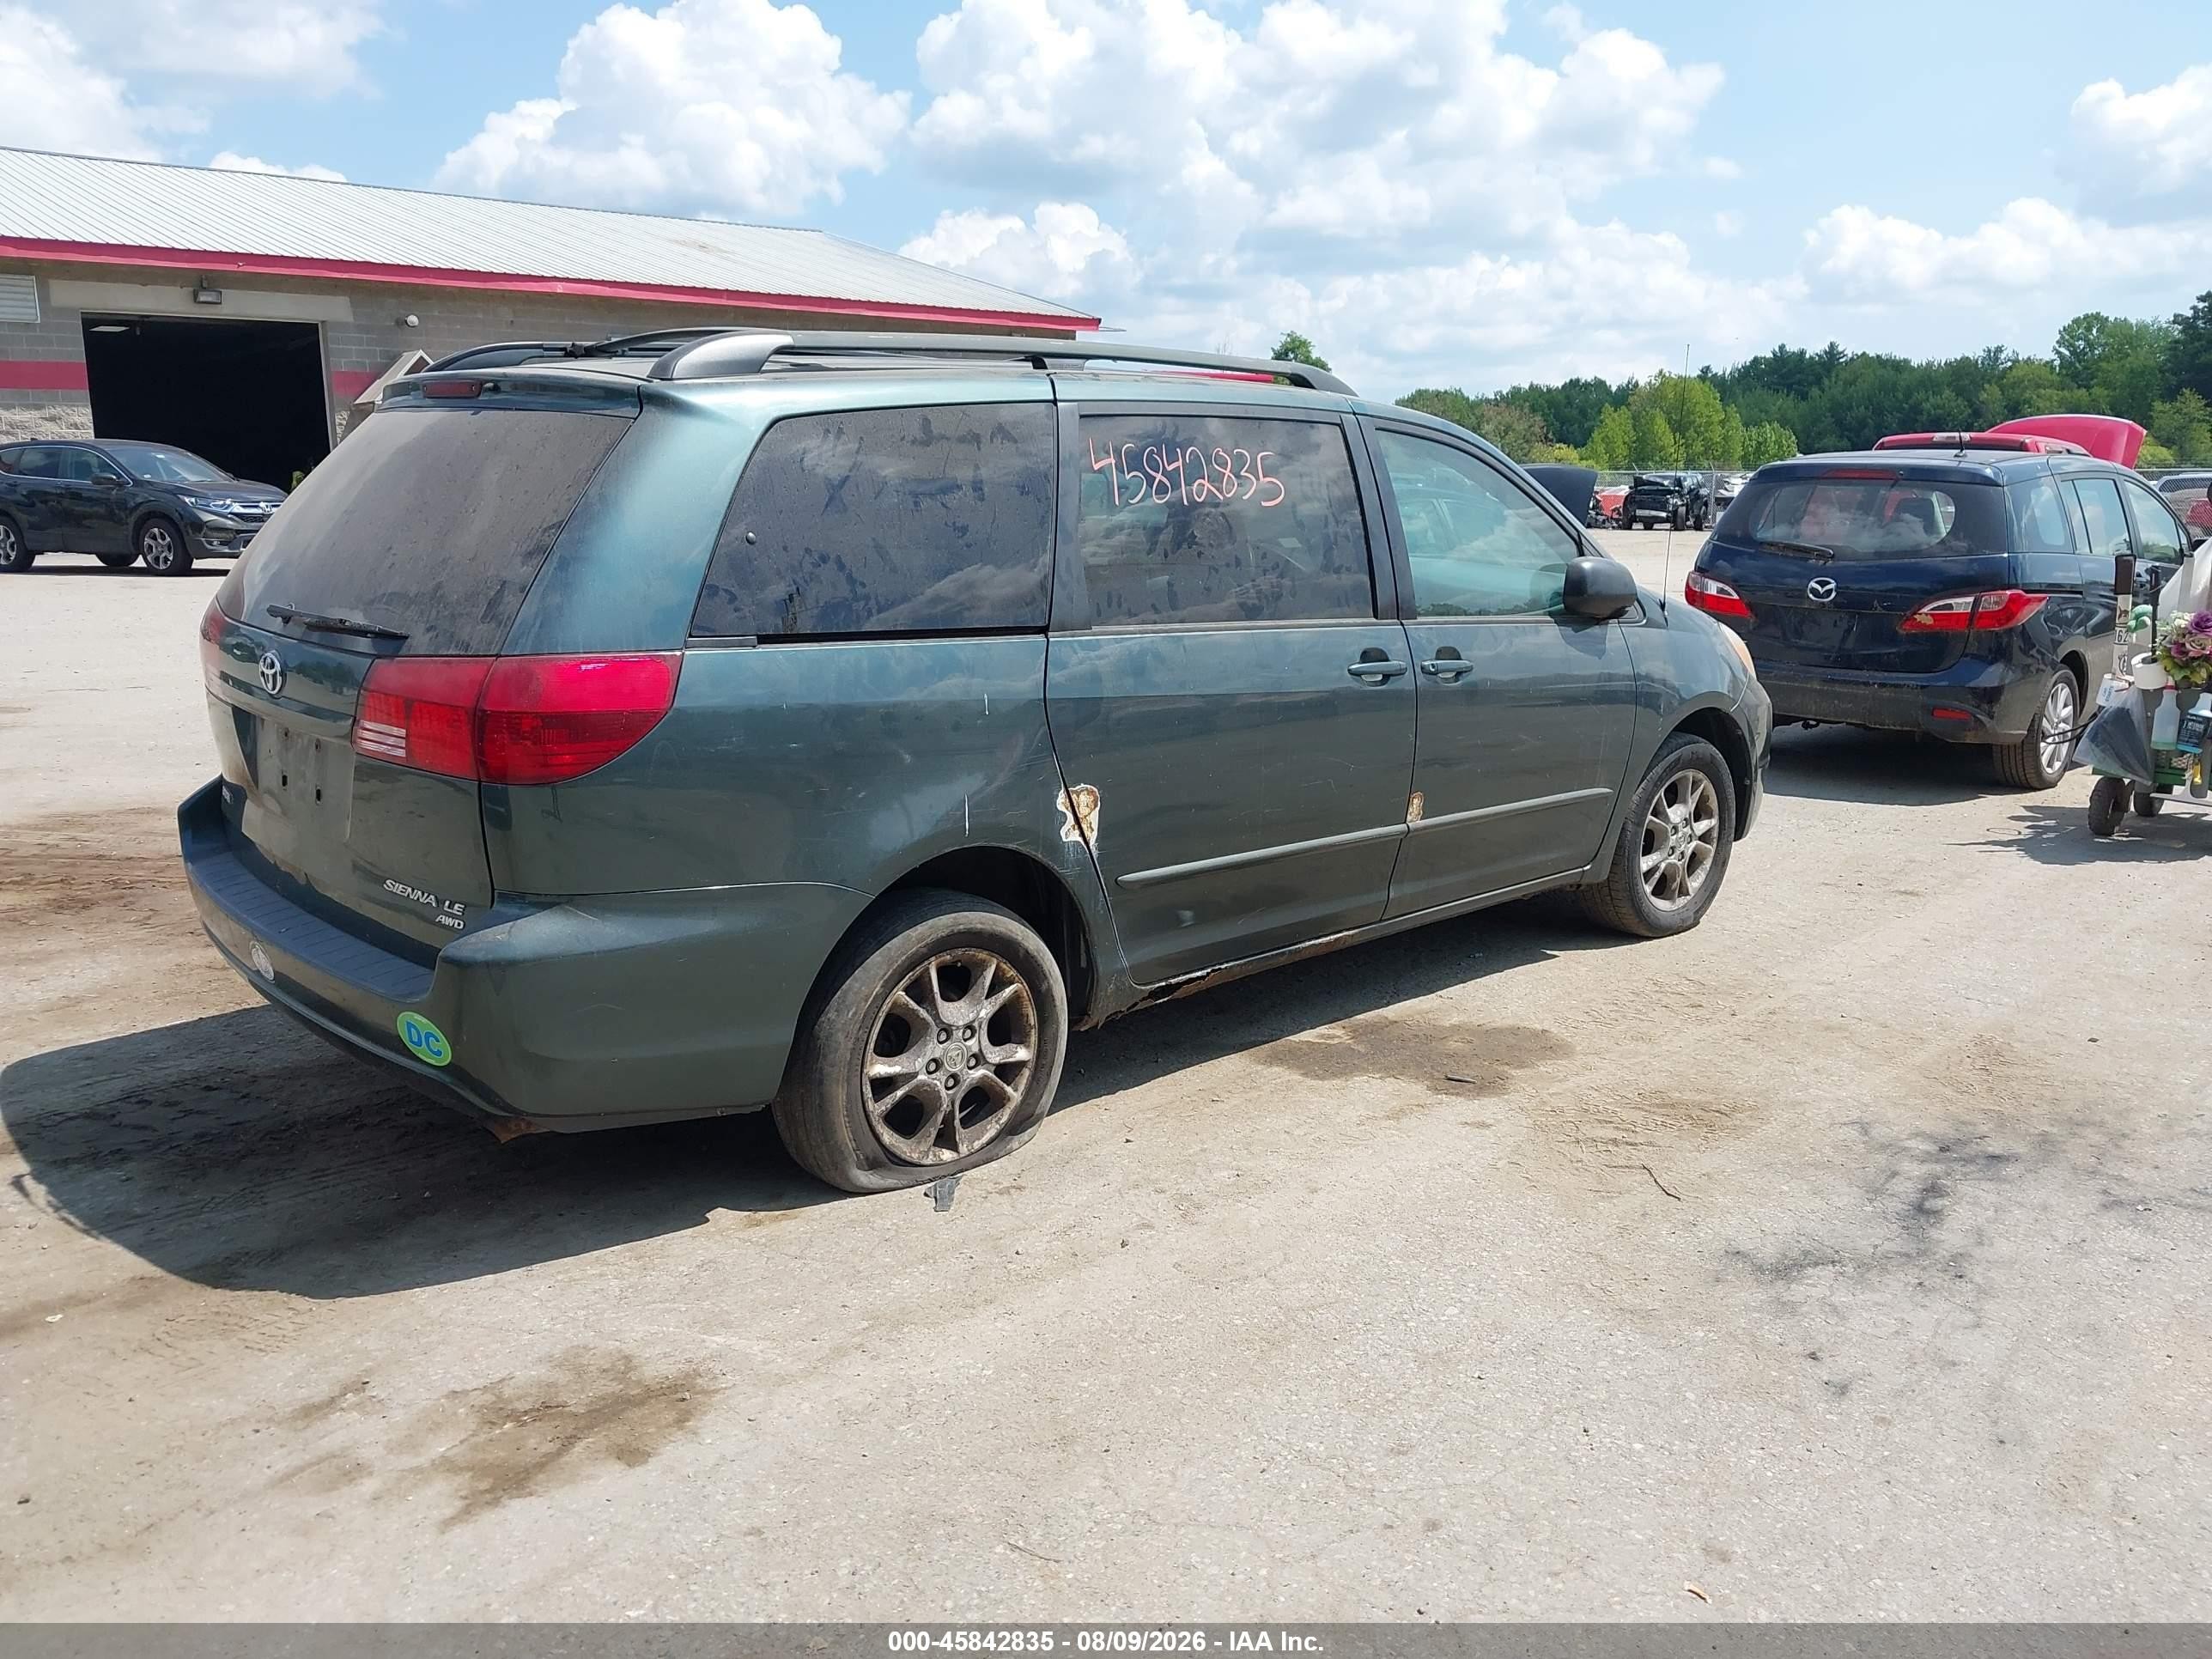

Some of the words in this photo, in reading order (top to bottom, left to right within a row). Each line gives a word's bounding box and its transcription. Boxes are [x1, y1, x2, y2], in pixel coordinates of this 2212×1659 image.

[1088, 436, 1285, 507] 45842835
[383, 879, 437, 907] SIENNA
[443, 900, 465, 915] LE
[434, 915, 465, 929] AWD
[405, 1019, 443, 1058] DC
